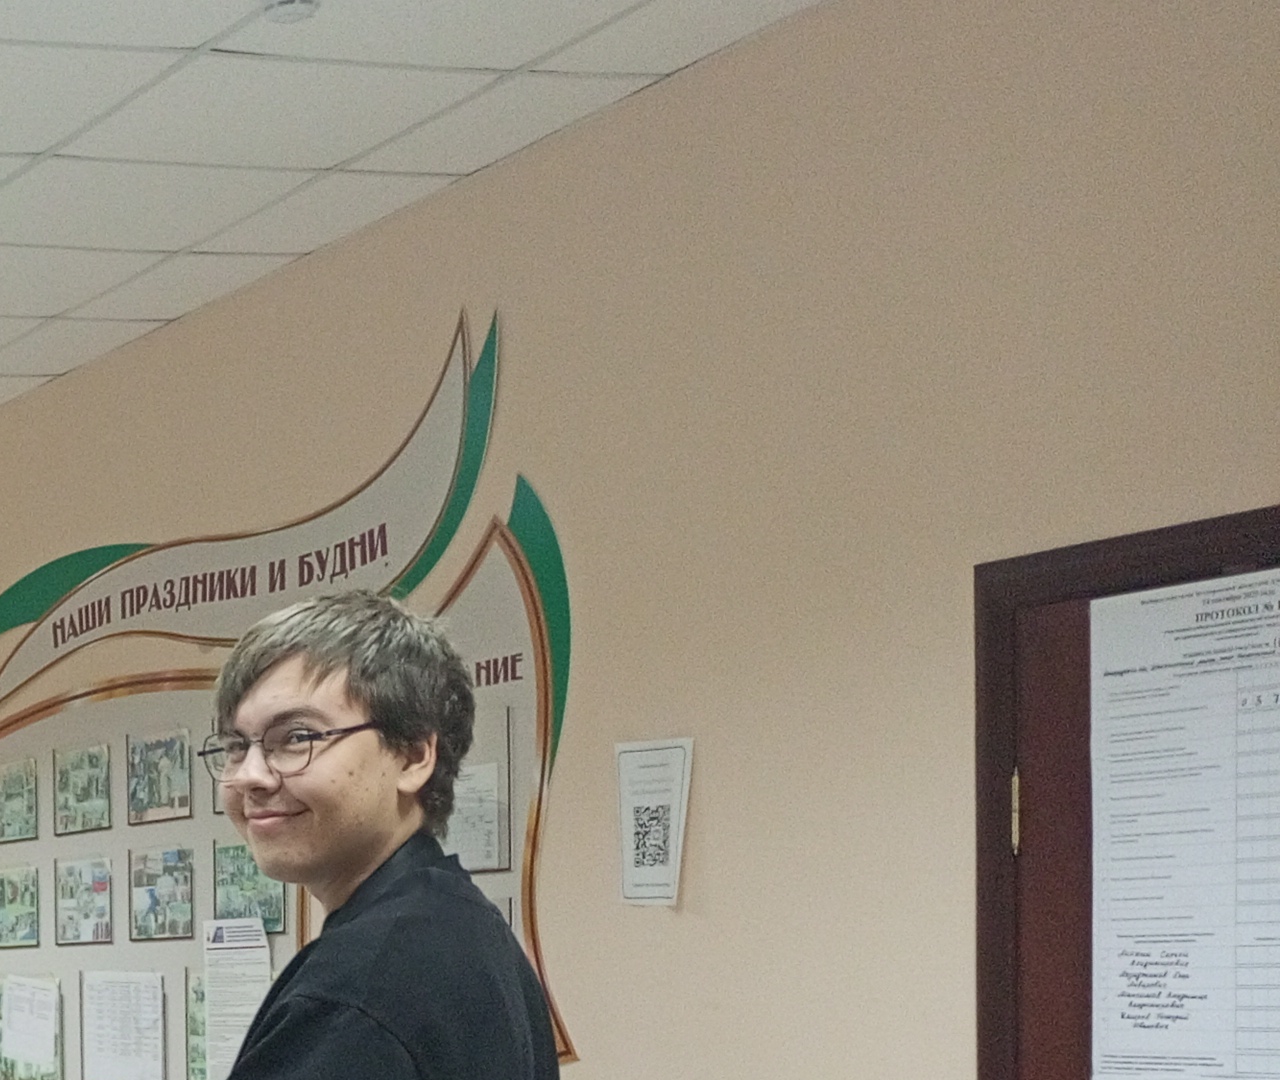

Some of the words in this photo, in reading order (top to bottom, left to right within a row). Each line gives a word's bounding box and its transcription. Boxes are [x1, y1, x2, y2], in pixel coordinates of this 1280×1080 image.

[52, 595, 111, 649] НАШИ
[120, 565, 257, 620] ПРАЗДНИКИ
[268, 558, 286, 593] И
[298, 522, 389, 588] БУДНИ
[1195, 604, 1259, 622] ПРОТОКОЛ
[475, 652, 523, 687] НИЕ
